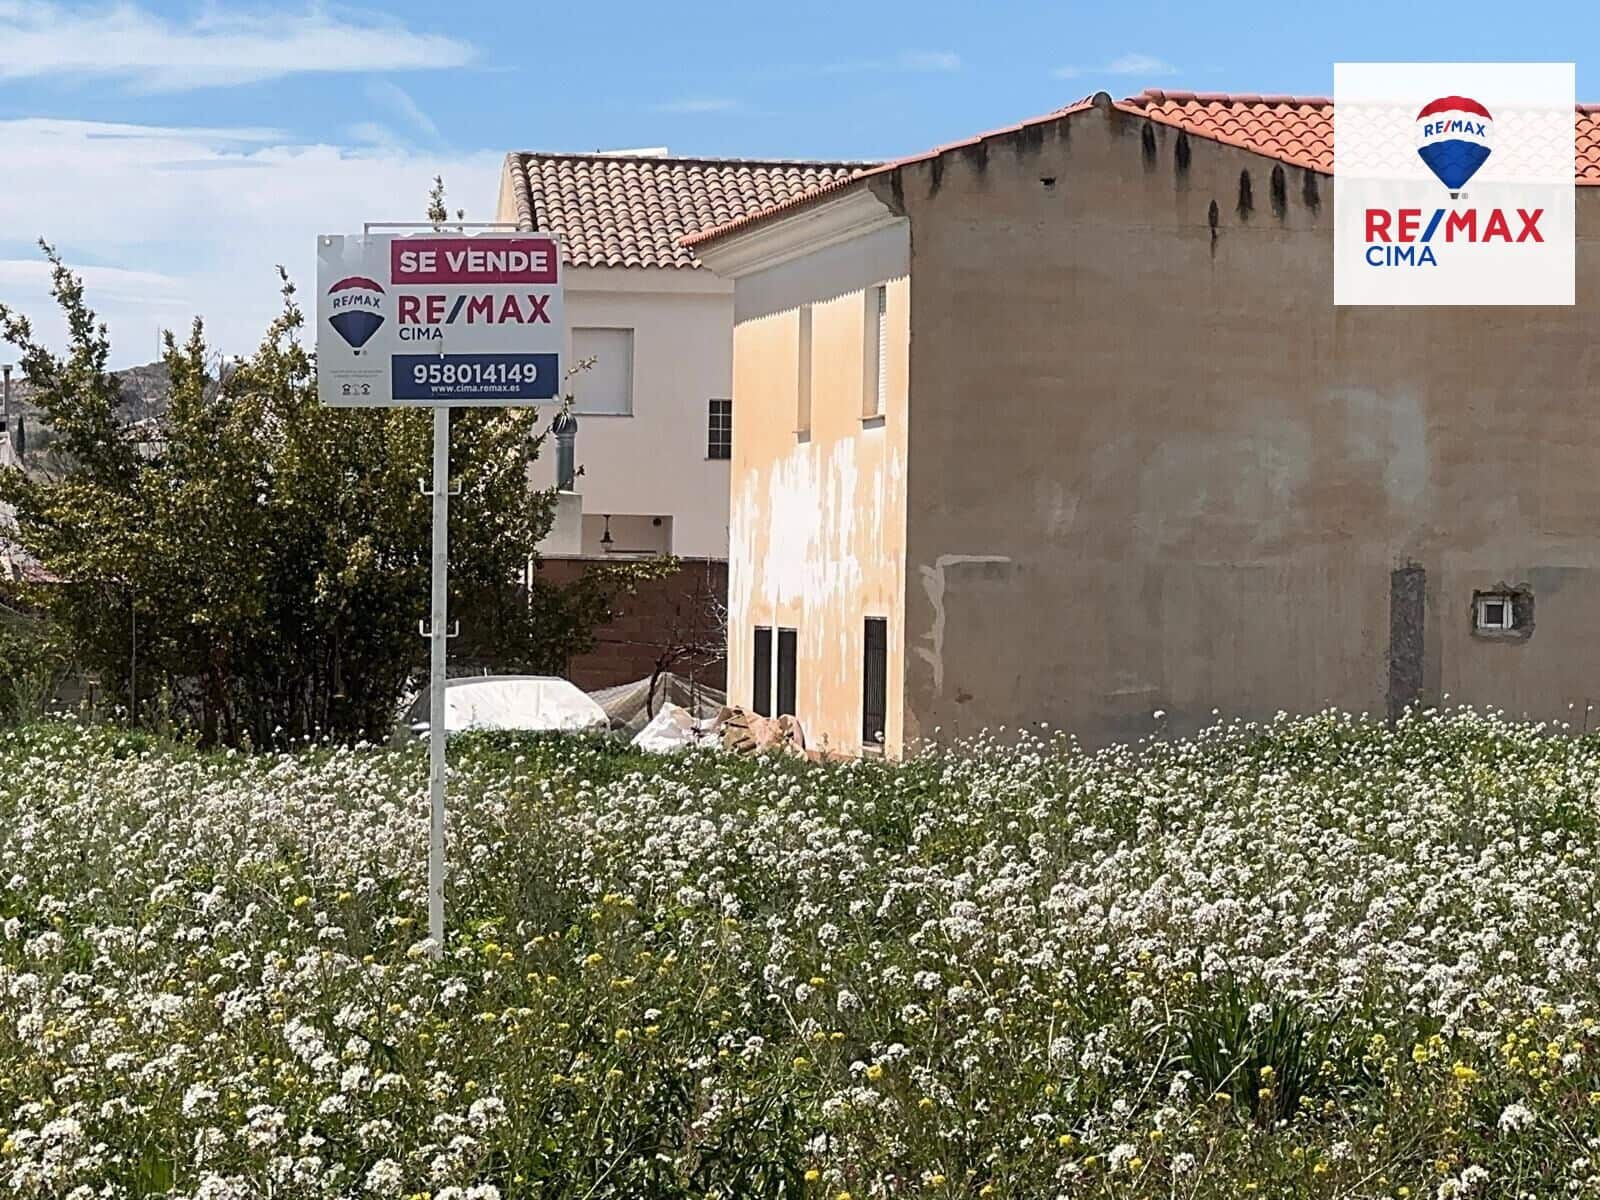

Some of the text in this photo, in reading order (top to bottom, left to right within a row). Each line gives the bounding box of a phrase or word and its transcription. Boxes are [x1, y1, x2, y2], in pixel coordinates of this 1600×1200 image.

[399, 250, 548, 273] SE VENDE
[333, 294, 381, 309] RE/MAX
[398, 294, 551, 325] RE/MAX
[399, 327, 443, 341] CIMA
[413, 363, 537, 384] 958014149
[431, 384, 520, 393] www.cima.remax.es
